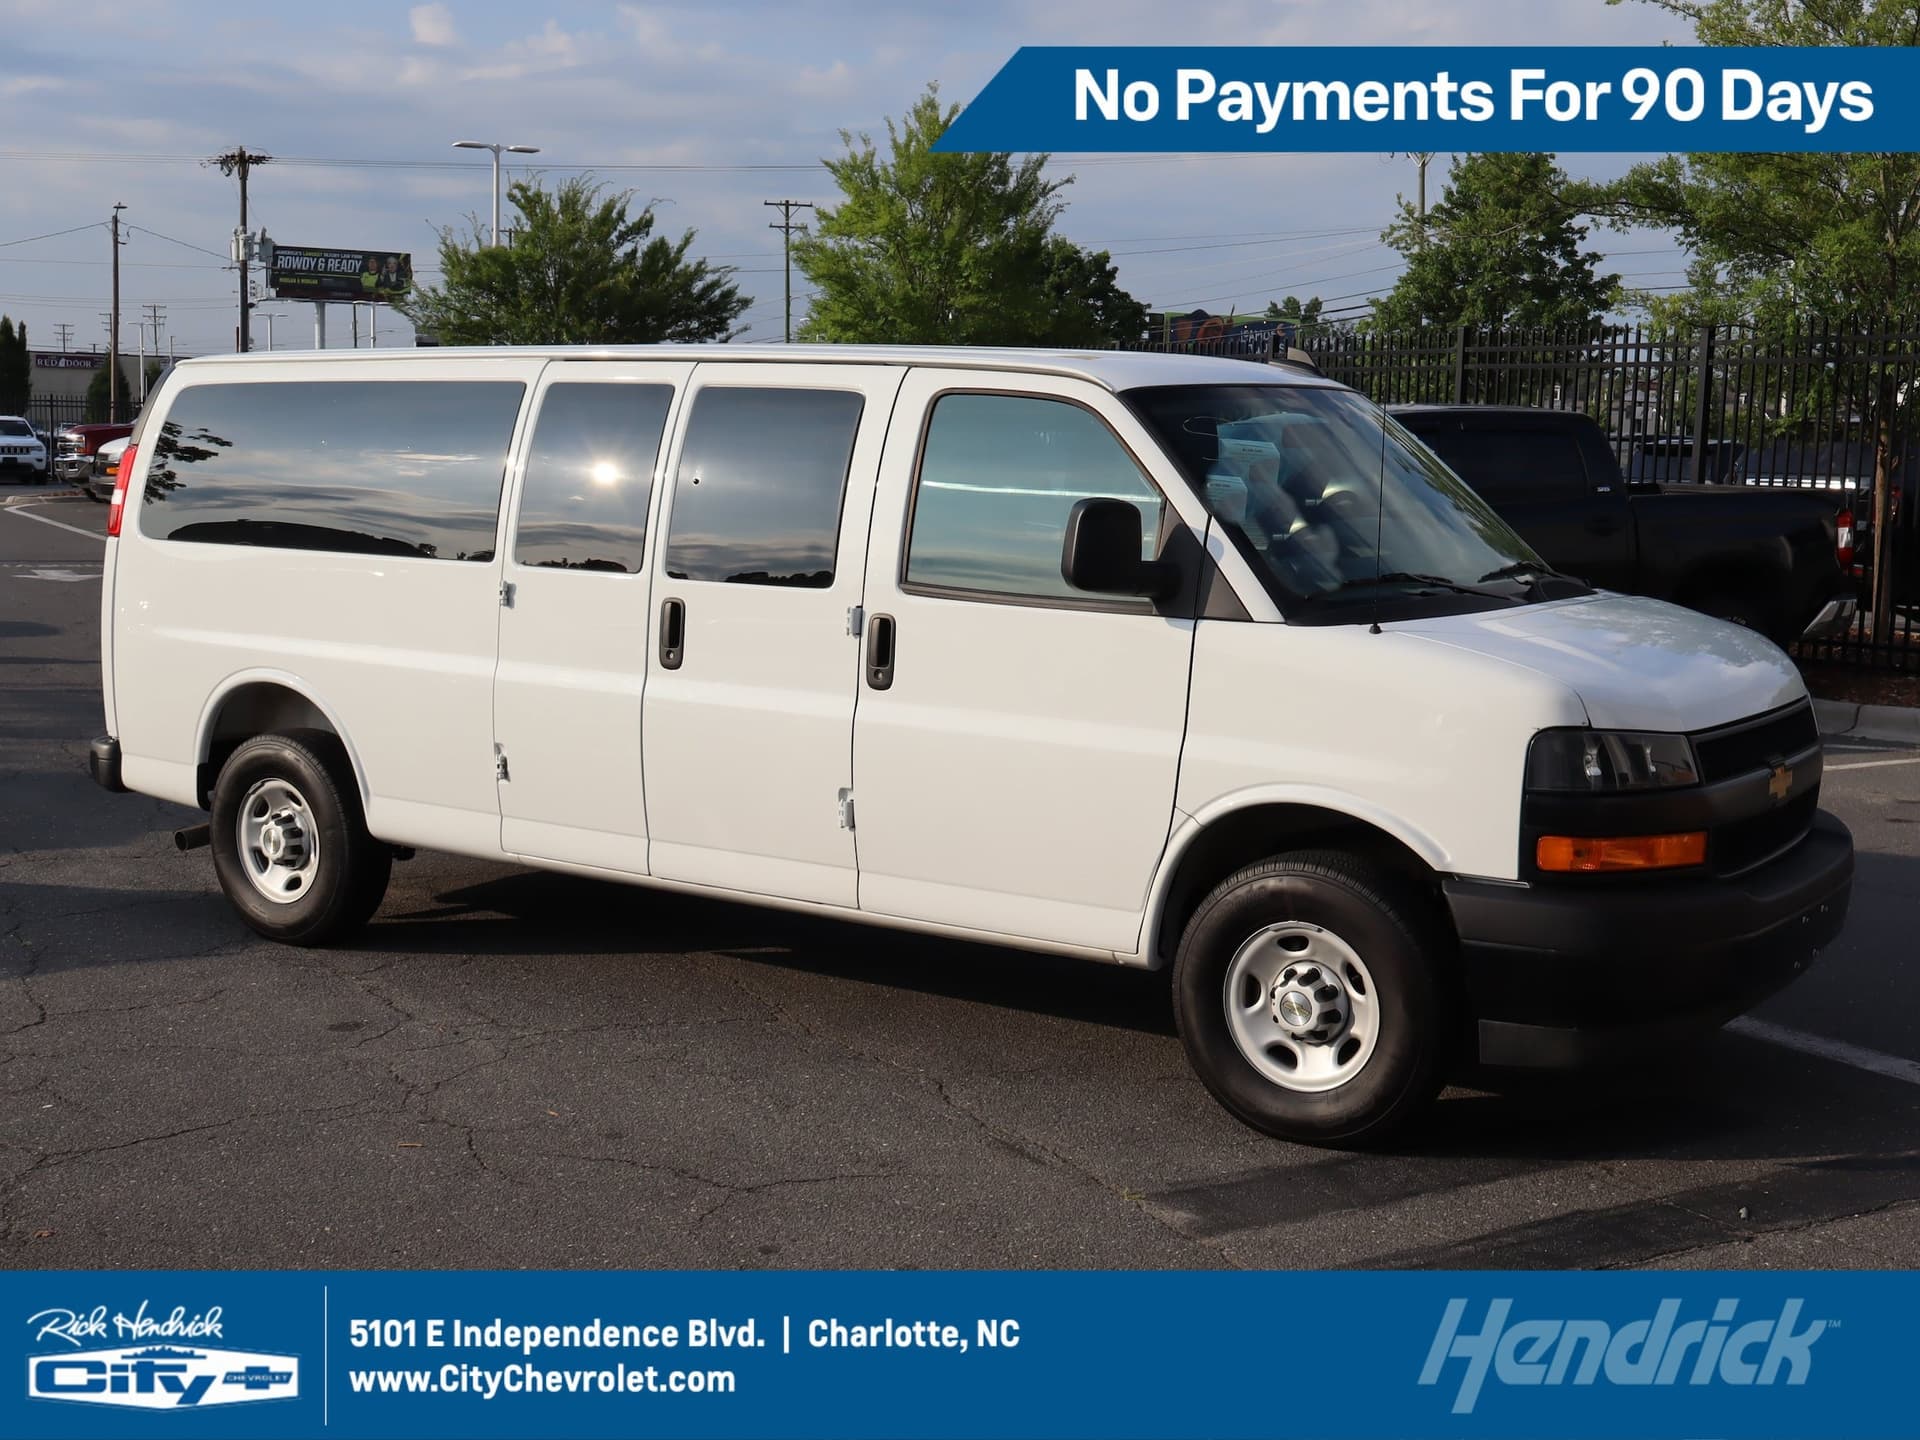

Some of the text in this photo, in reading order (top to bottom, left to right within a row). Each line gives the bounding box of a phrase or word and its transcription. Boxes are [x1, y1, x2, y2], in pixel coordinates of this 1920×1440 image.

[277, 255, 316, 271] ROWDY
[327, 259, 362, 273] READY
[37, 358, 58, 367] RED
[66, 359, 92, 368] DOOR
